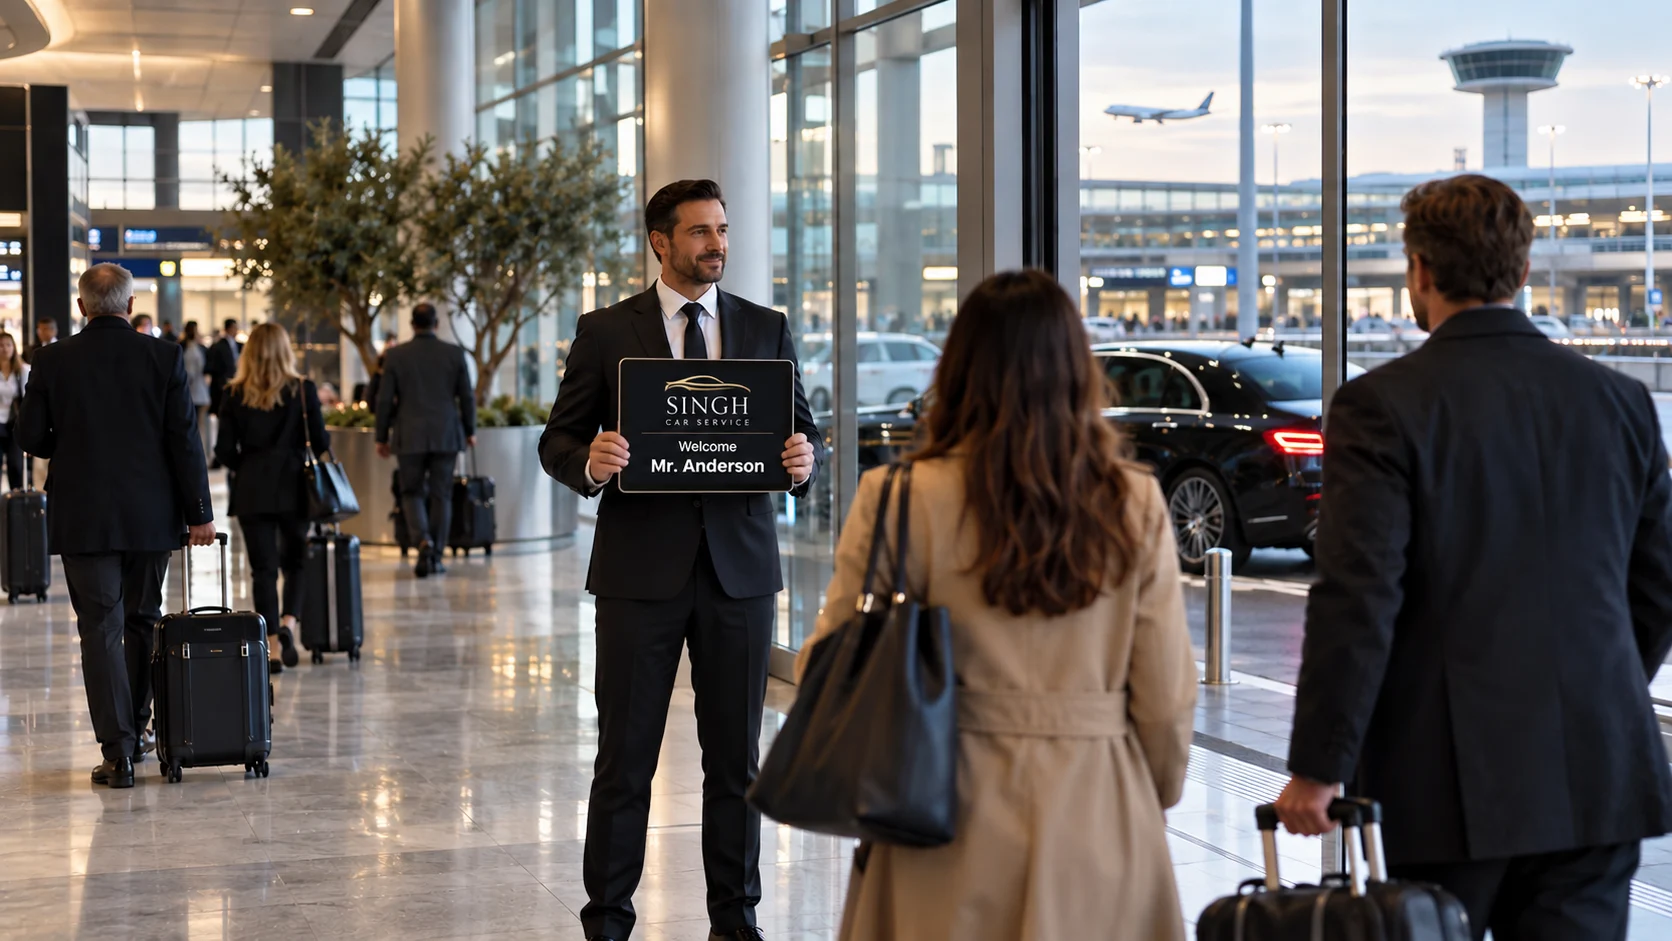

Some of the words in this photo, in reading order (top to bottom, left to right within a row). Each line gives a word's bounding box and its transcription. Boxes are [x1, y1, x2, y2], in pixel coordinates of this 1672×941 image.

[666, 396, 749, 415] SINGH
[665, 418, 689, 426] CAR
[696, 418, 750, 426] SERVICE
[678, 440, 737, 452] Welcome
[651, 459, 677, 473] Mr.
[682, 458, 765, 473] Anderson
